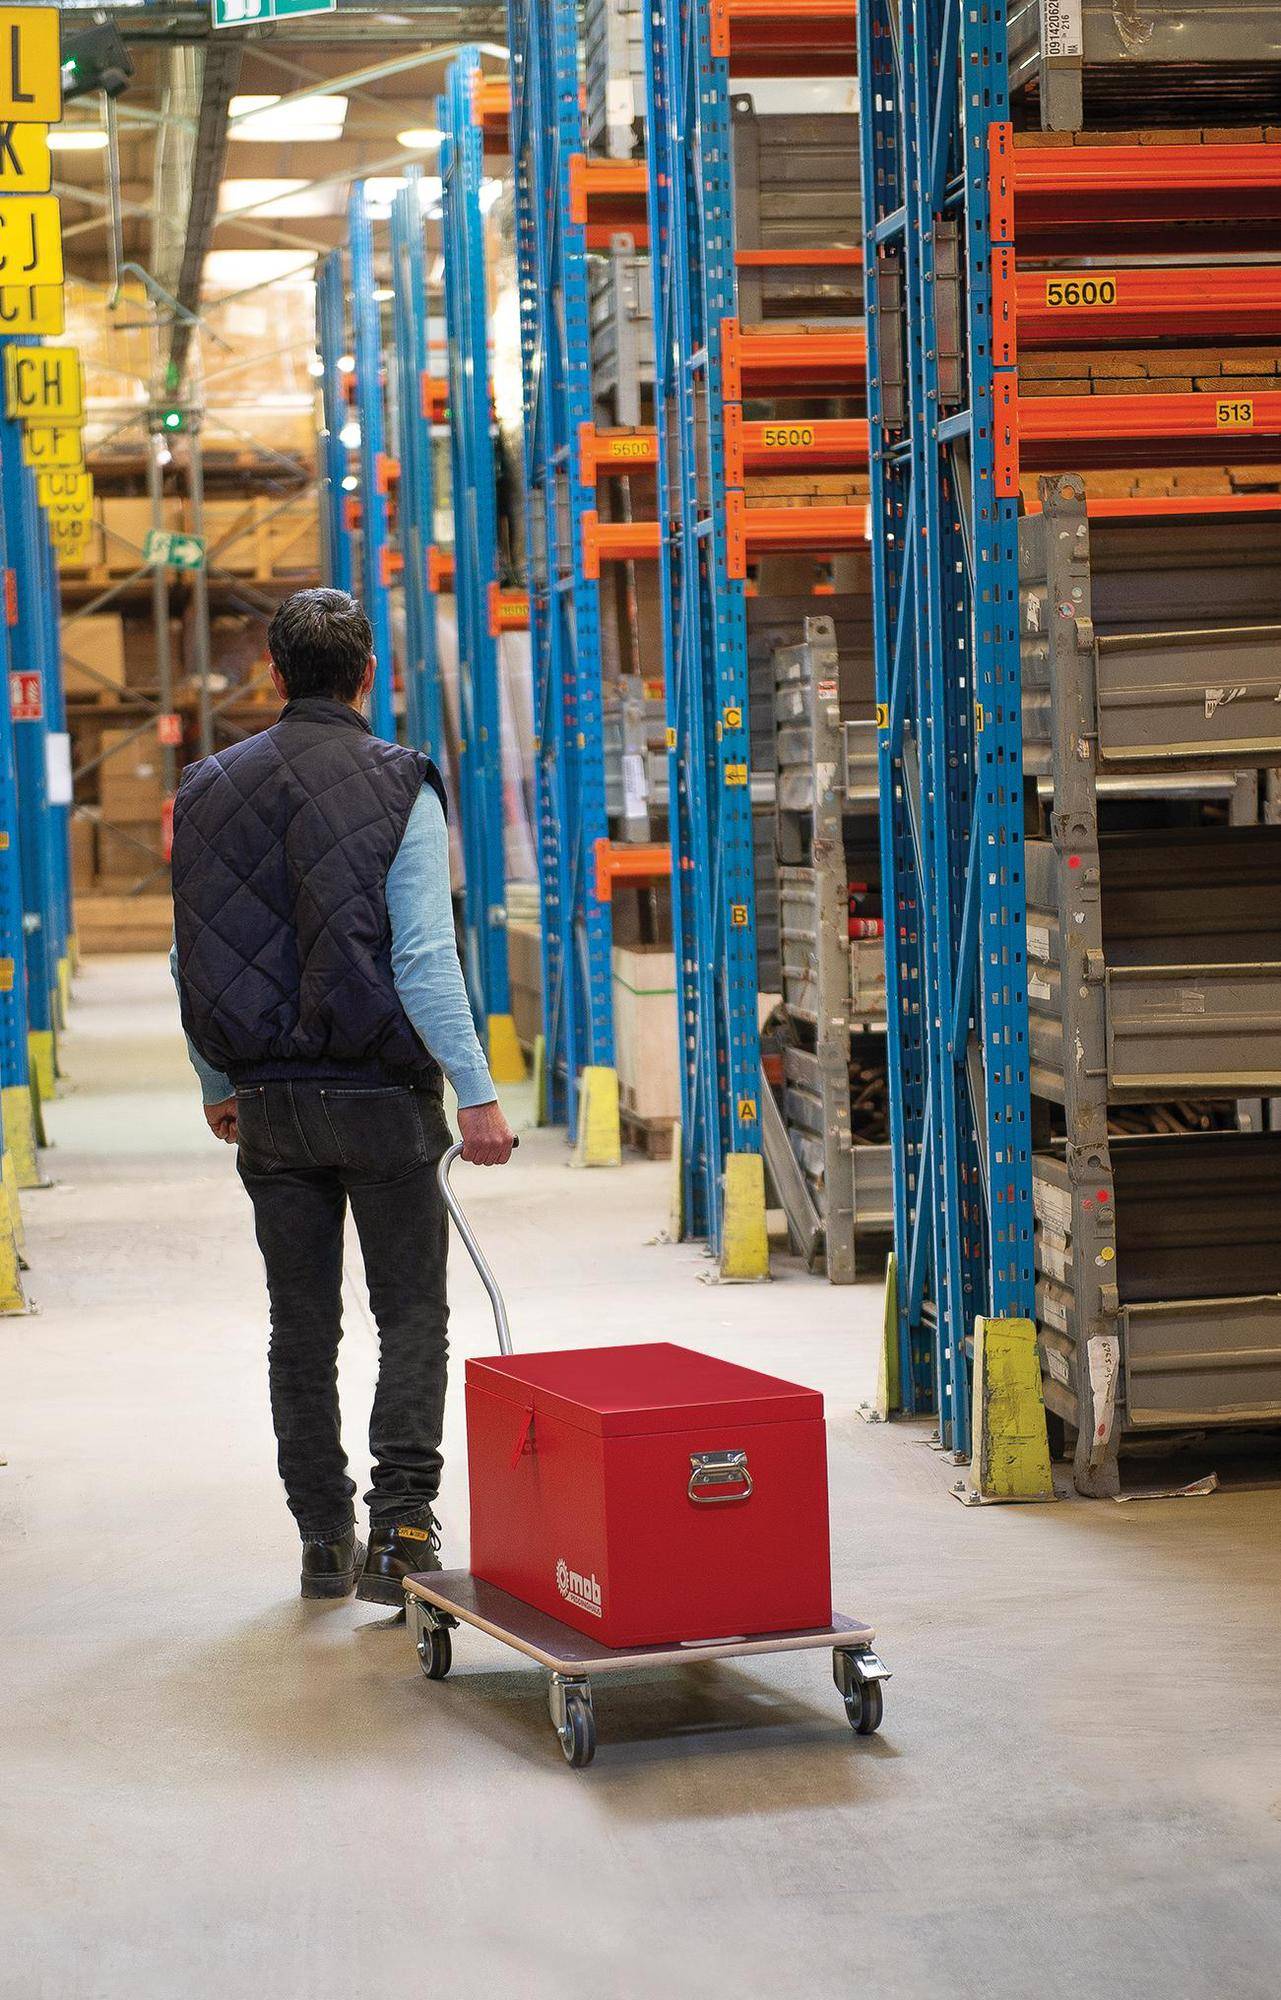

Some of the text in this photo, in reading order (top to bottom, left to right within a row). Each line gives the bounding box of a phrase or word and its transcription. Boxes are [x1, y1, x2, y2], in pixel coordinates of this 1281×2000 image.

[1060, 14, 1070, 30] 216
[11, 24, 35, 102] L
[1047, 281, 1115, 306] 5600
[16, 359, 62, 406] CH
[1219, 404, 1252, 422] 513
[765, 429, 813, 446] 5600
[613, 441, 650, 456] 5600
[726, 709, 741, 726] C
[733, 907, 747, 923] B
[741, 1102, 755, 1119] A
[569, 1570, 602, 1606] mob
